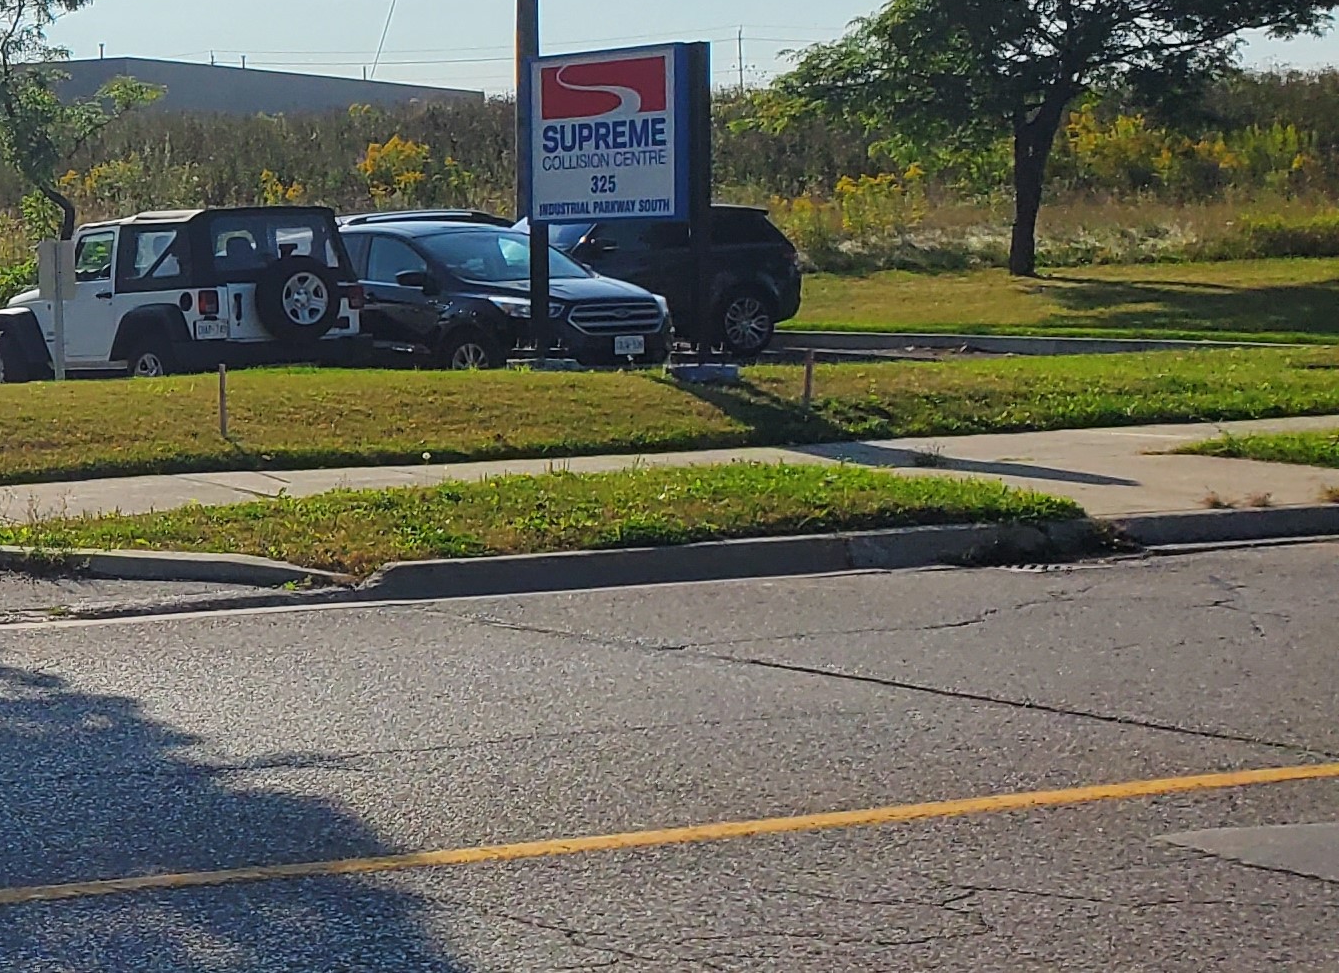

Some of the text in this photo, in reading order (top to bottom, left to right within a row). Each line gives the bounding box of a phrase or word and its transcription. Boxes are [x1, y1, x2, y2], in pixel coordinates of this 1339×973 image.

[542, 117, 667, 154] SUPREME
[542, 149, 667, 171] COLLISION CENTRE
[590, 175, 617, 194] 325
[539, 198, 670, 216] INDUSTRIAL PARKWAY SOUTH
